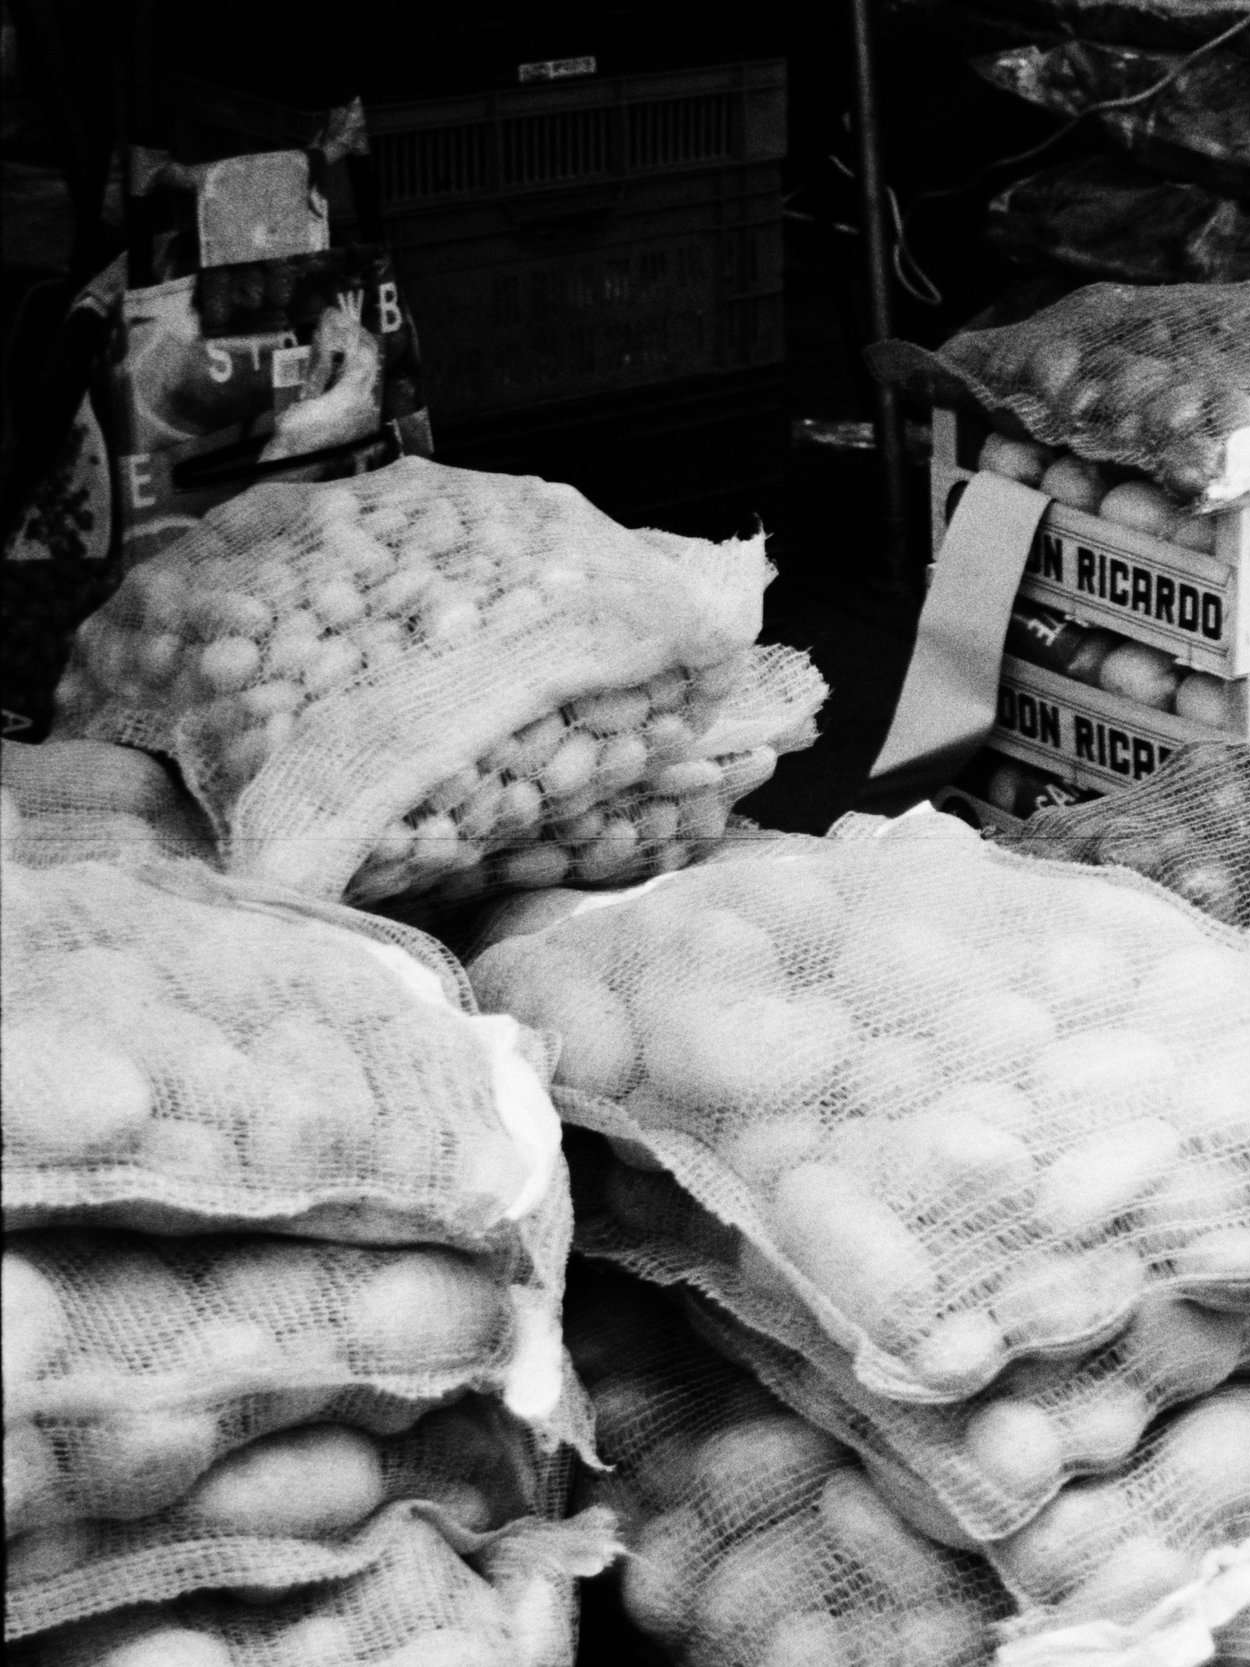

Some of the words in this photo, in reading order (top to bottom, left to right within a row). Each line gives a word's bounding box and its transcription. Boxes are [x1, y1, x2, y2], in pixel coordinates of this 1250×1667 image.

[1077, 546, 1223, 641] RICARDO
[1000, 683, 1061, 749] DON
[1074, 714, 1172, 781] RICA
